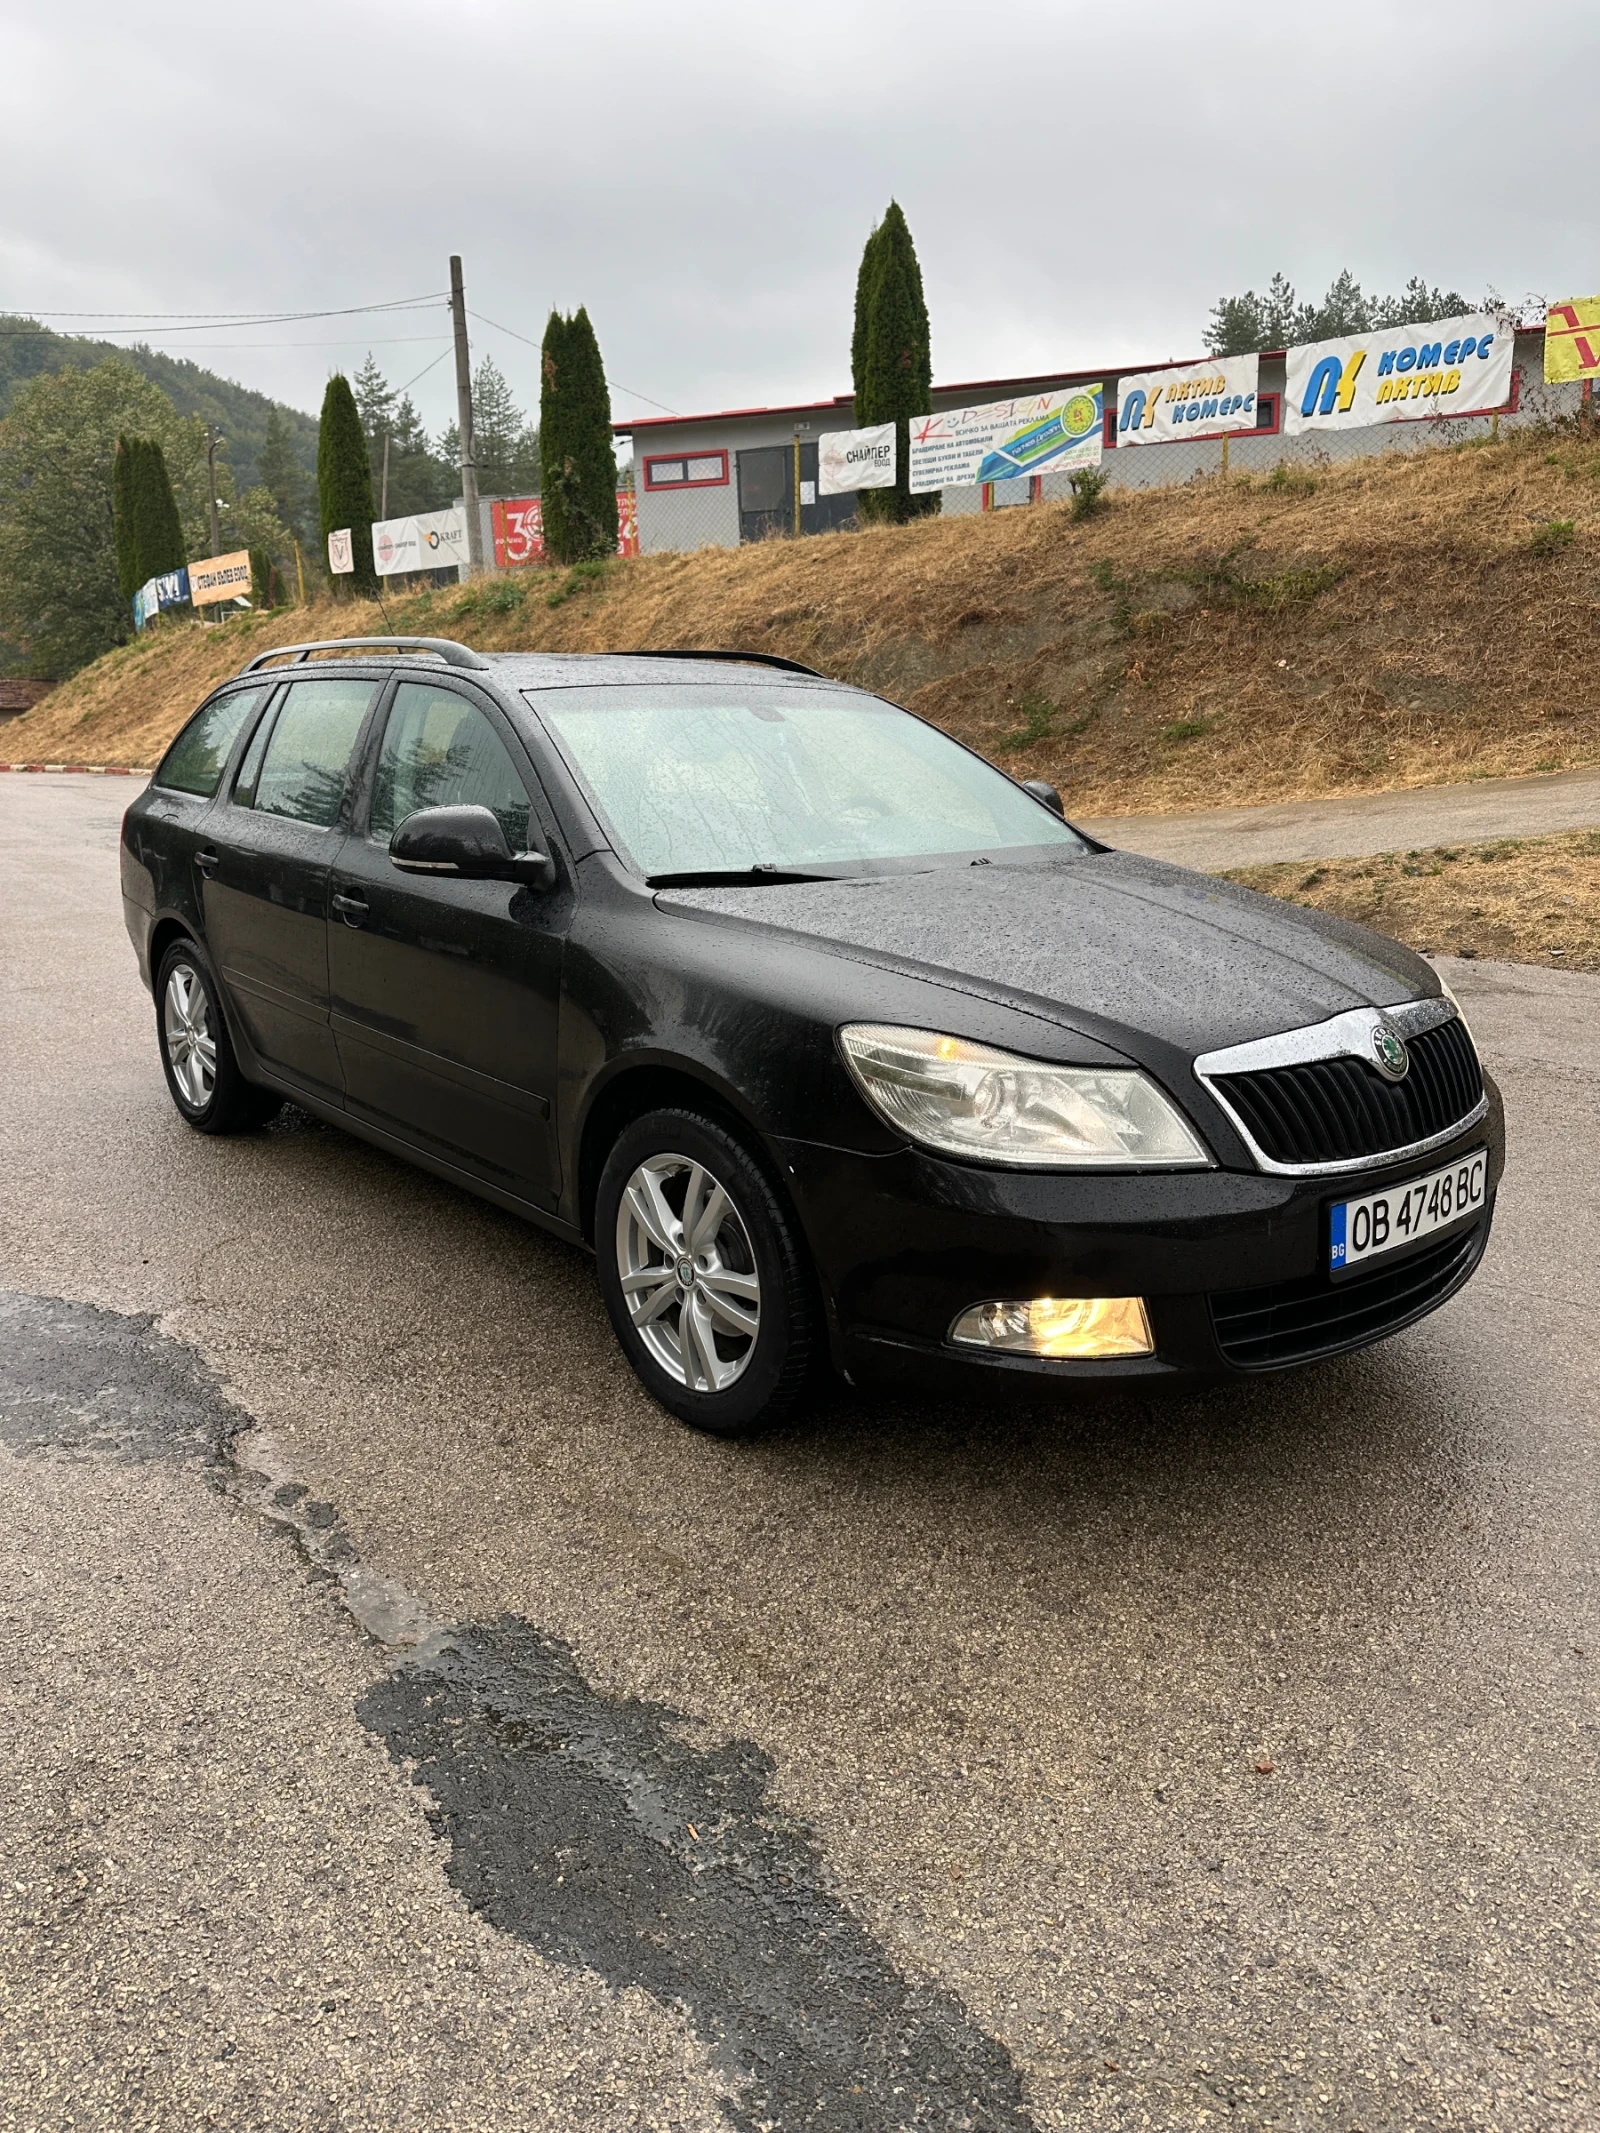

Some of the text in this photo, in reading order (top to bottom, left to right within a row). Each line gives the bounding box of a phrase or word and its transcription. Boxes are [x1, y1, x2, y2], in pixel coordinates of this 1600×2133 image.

[1377, 333, 1494, 377] КОМЕРС
[1165, 375, 1225, 403] АКТИВ
[1376, 368, 1461, 405] АКТИВ
[1172, 392, 1255, 424] КОМЕРС
[955, 426, 979, 436] ВСИЧКО
[990, 420, 1017, 430] ВАШАТА
[1018, 414, 1050, 425] РЕКЛАМА
[955, 435, 993, 447] АВТОМОБИЛИ
[846, 445, 890, 463] СНАЙПЕР
[943, 462, 970, 472] РЕКЛАМА
[440, 529, 462, 541] KRAFT
[1352, 1159, 1483, 1251] OB 4748 BC
[1331, 1243, 1345, 1260] BG
